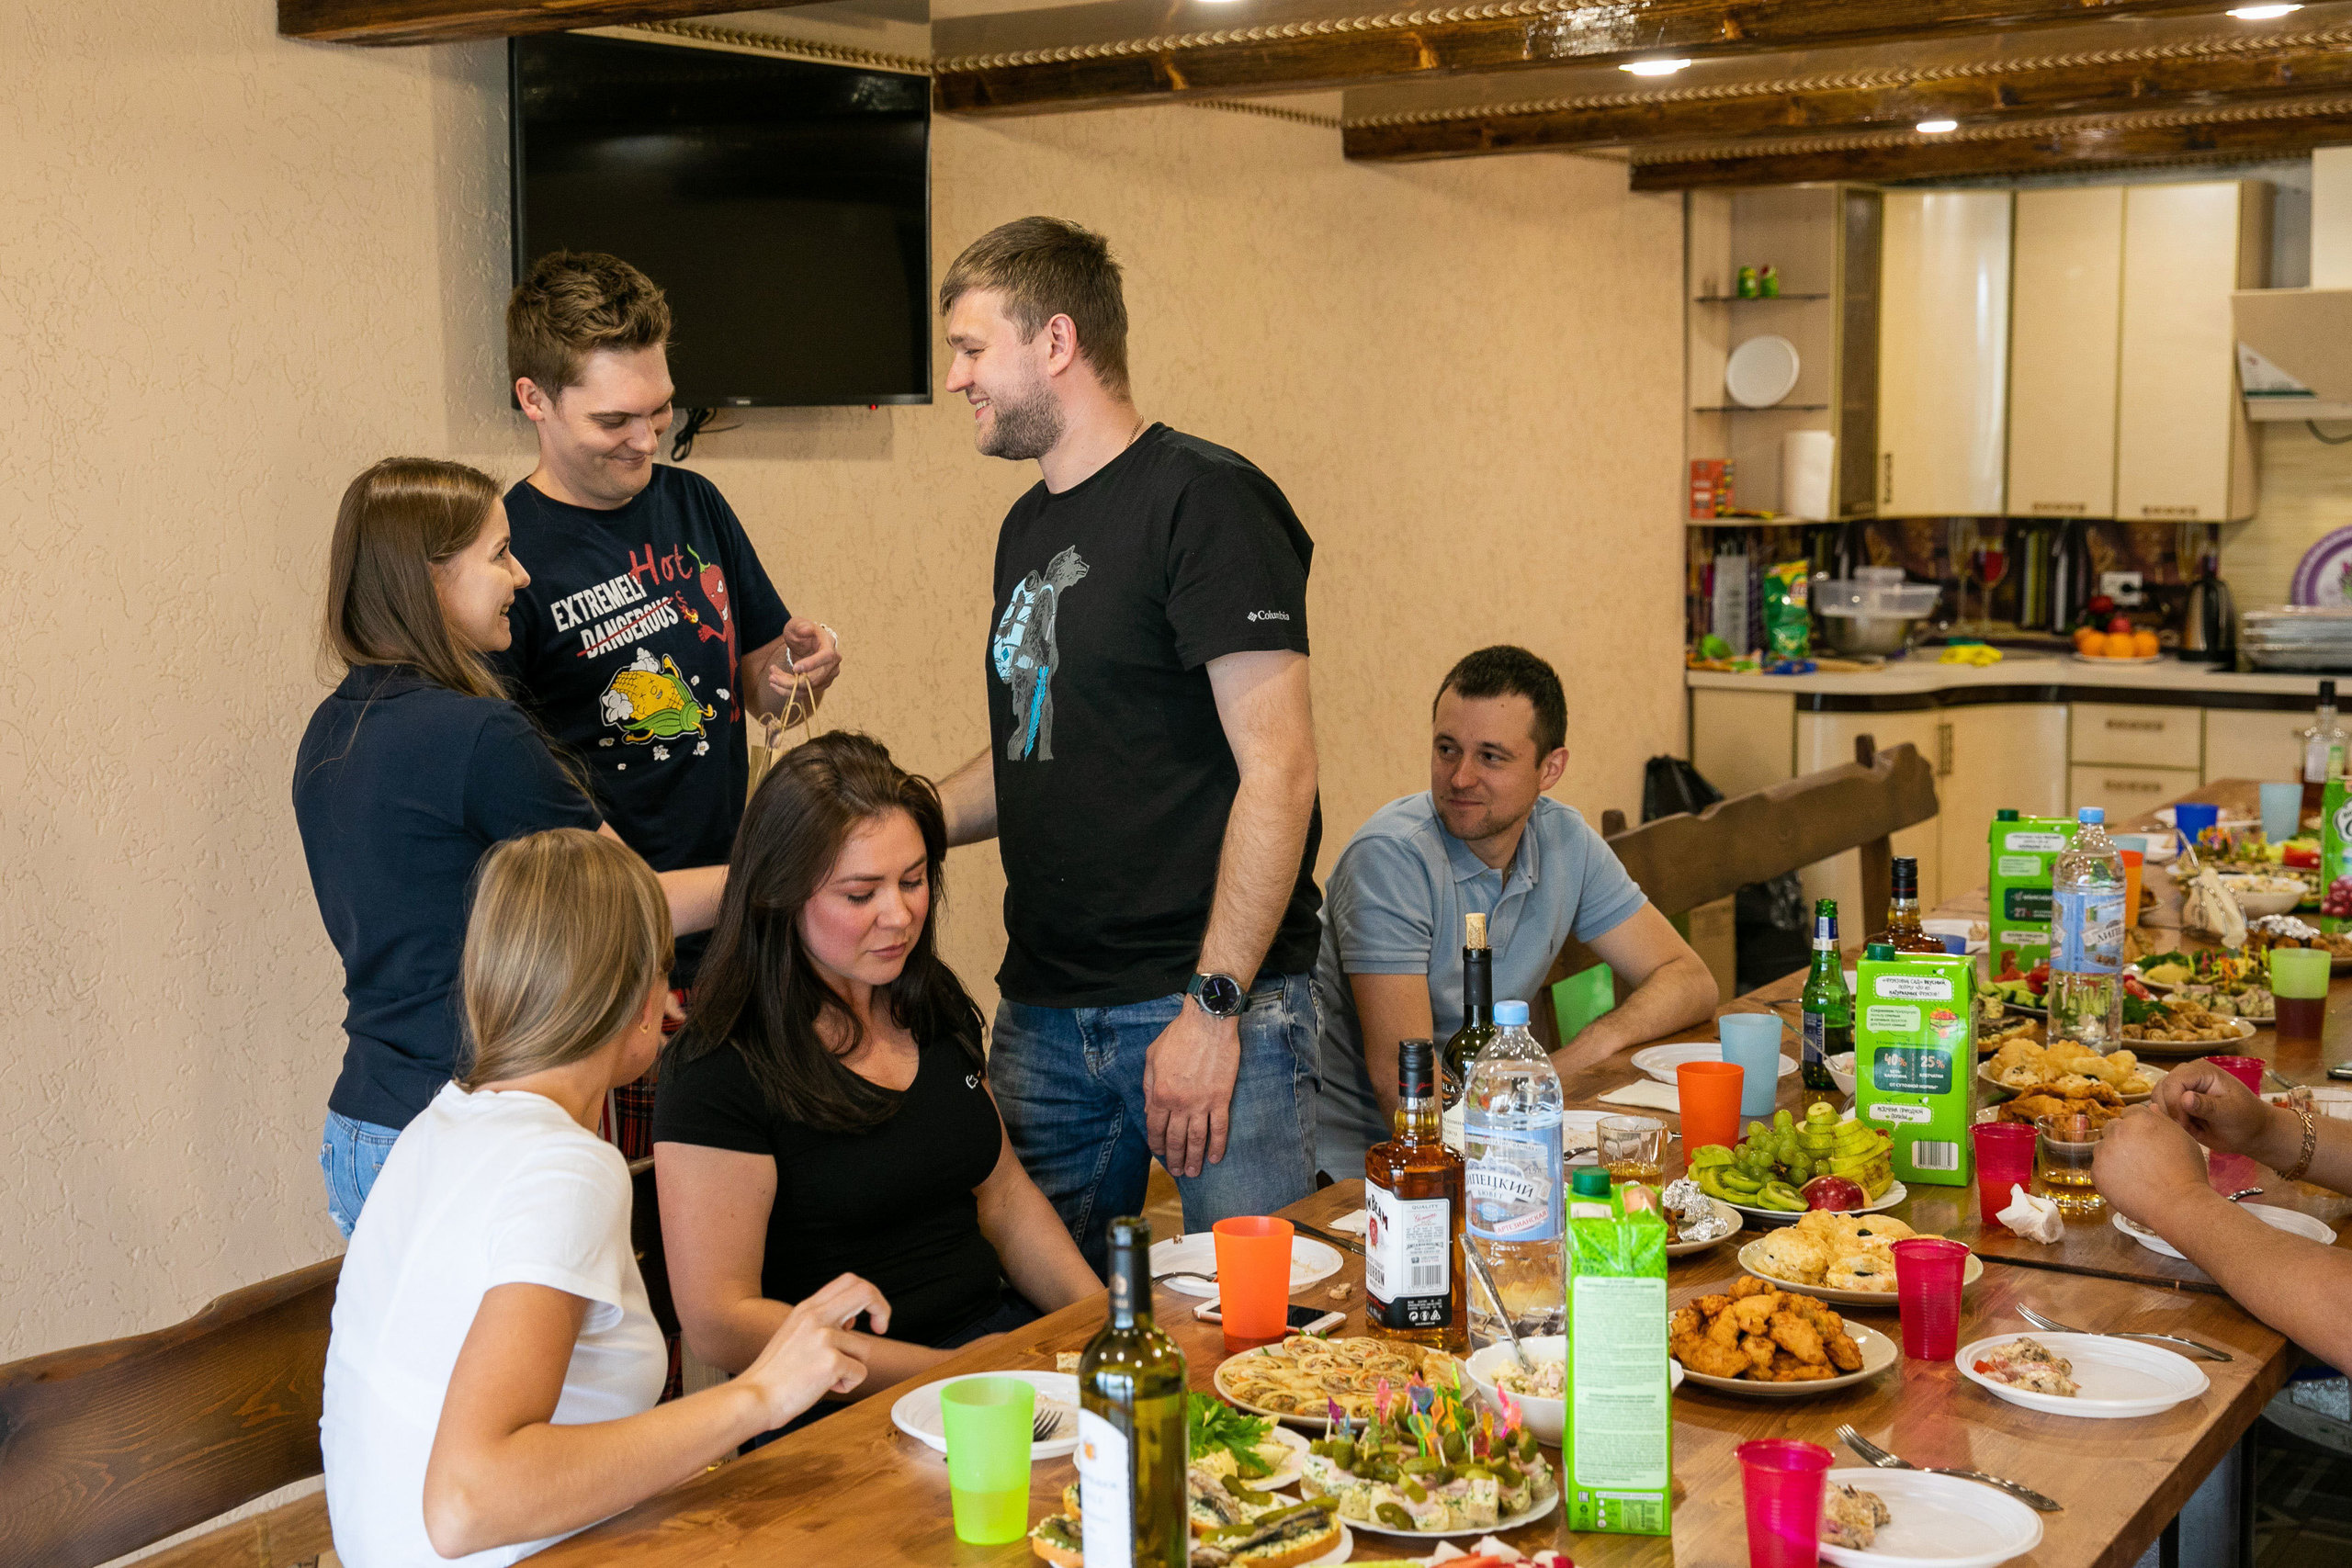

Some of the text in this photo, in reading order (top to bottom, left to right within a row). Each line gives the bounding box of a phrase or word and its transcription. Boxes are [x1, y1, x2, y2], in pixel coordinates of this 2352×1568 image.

[628, 543, 694, 586] Hot
[550, 571, 648, 633] EXTREMELY
[1257, 610, 1290, 621] Columbia
[580, 596, 679, 660] DANGEROUS
[1884, 1053, 1907, 1067] 40%
[1920, 1055, 1946, 1069] 25%
[1497, 1210, 1547, 1234] АРТЕЗИАНСКАЯ
